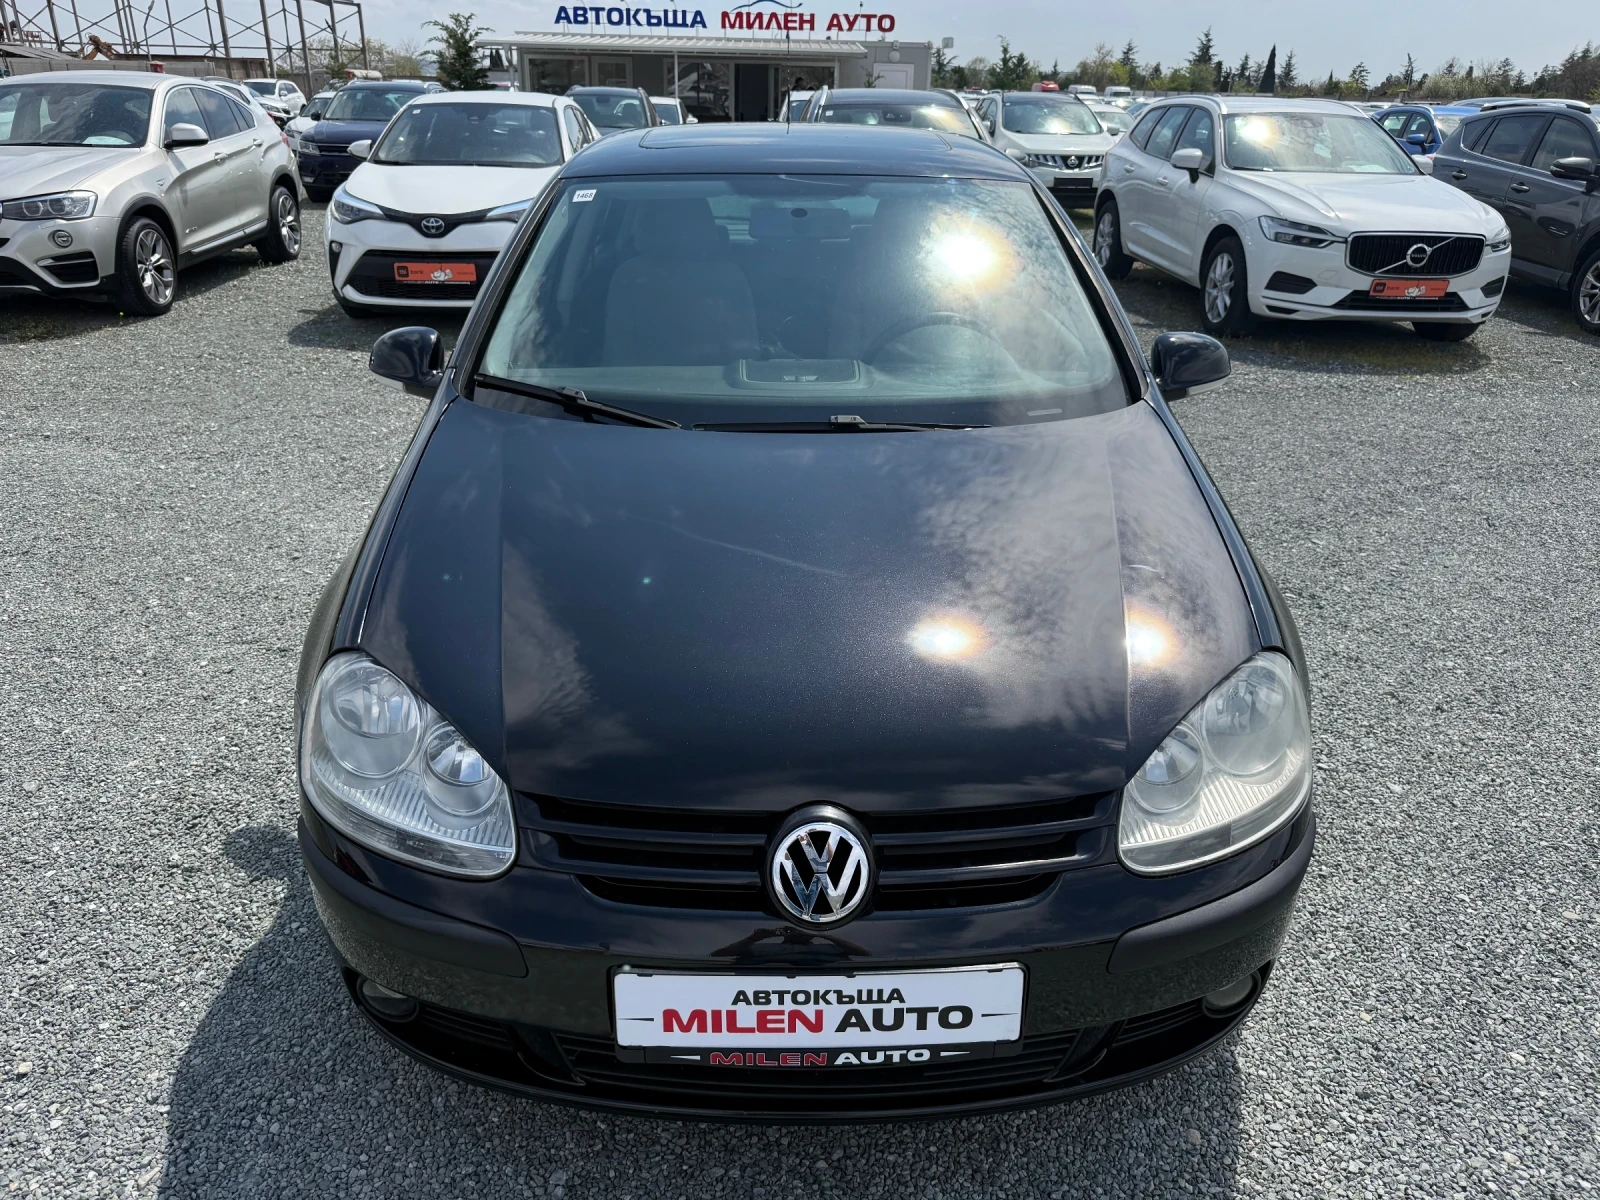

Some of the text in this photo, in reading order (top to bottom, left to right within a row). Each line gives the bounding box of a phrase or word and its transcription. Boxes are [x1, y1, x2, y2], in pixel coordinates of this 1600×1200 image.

[554, 5, 896, 33] АВТОКЪЩА МИЛЕН АУТО
[731, 987, 906, 1006] АВТОКЪЩА
[662, 1005, 974, 1034] MILEN AUTO
[709, 1048, 931, 1066] MILEN AUTO
